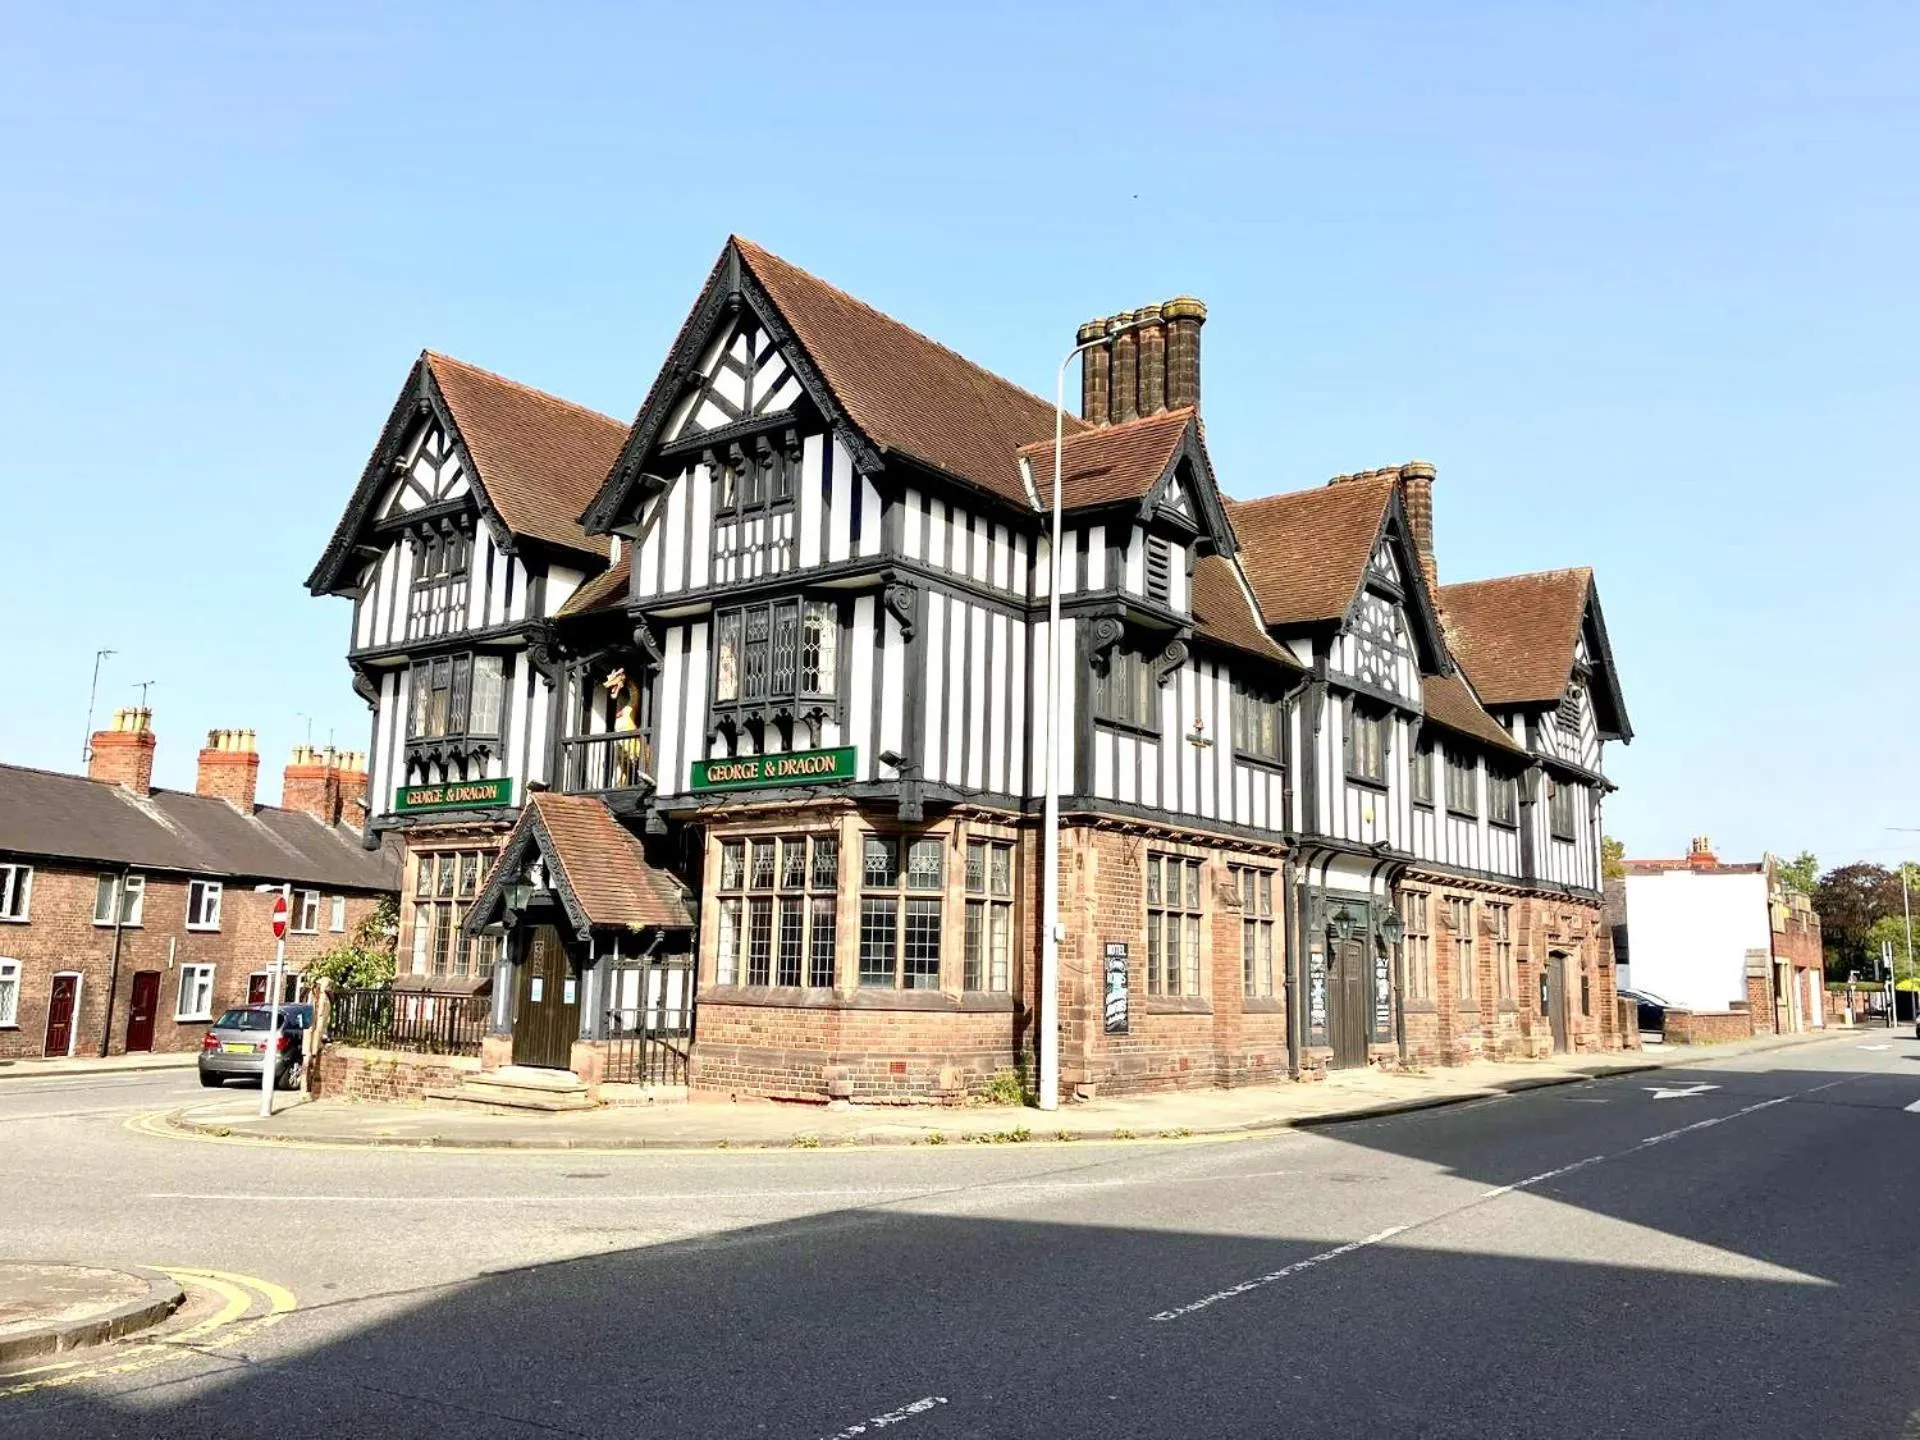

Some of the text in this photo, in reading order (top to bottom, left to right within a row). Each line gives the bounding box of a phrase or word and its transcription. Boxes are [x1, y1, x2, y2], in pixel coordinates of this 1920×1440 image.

[707, 756, 836, 782] GEORGE & DRAGON
[407, 785, 497, 805] GEORGE & DRAGON
